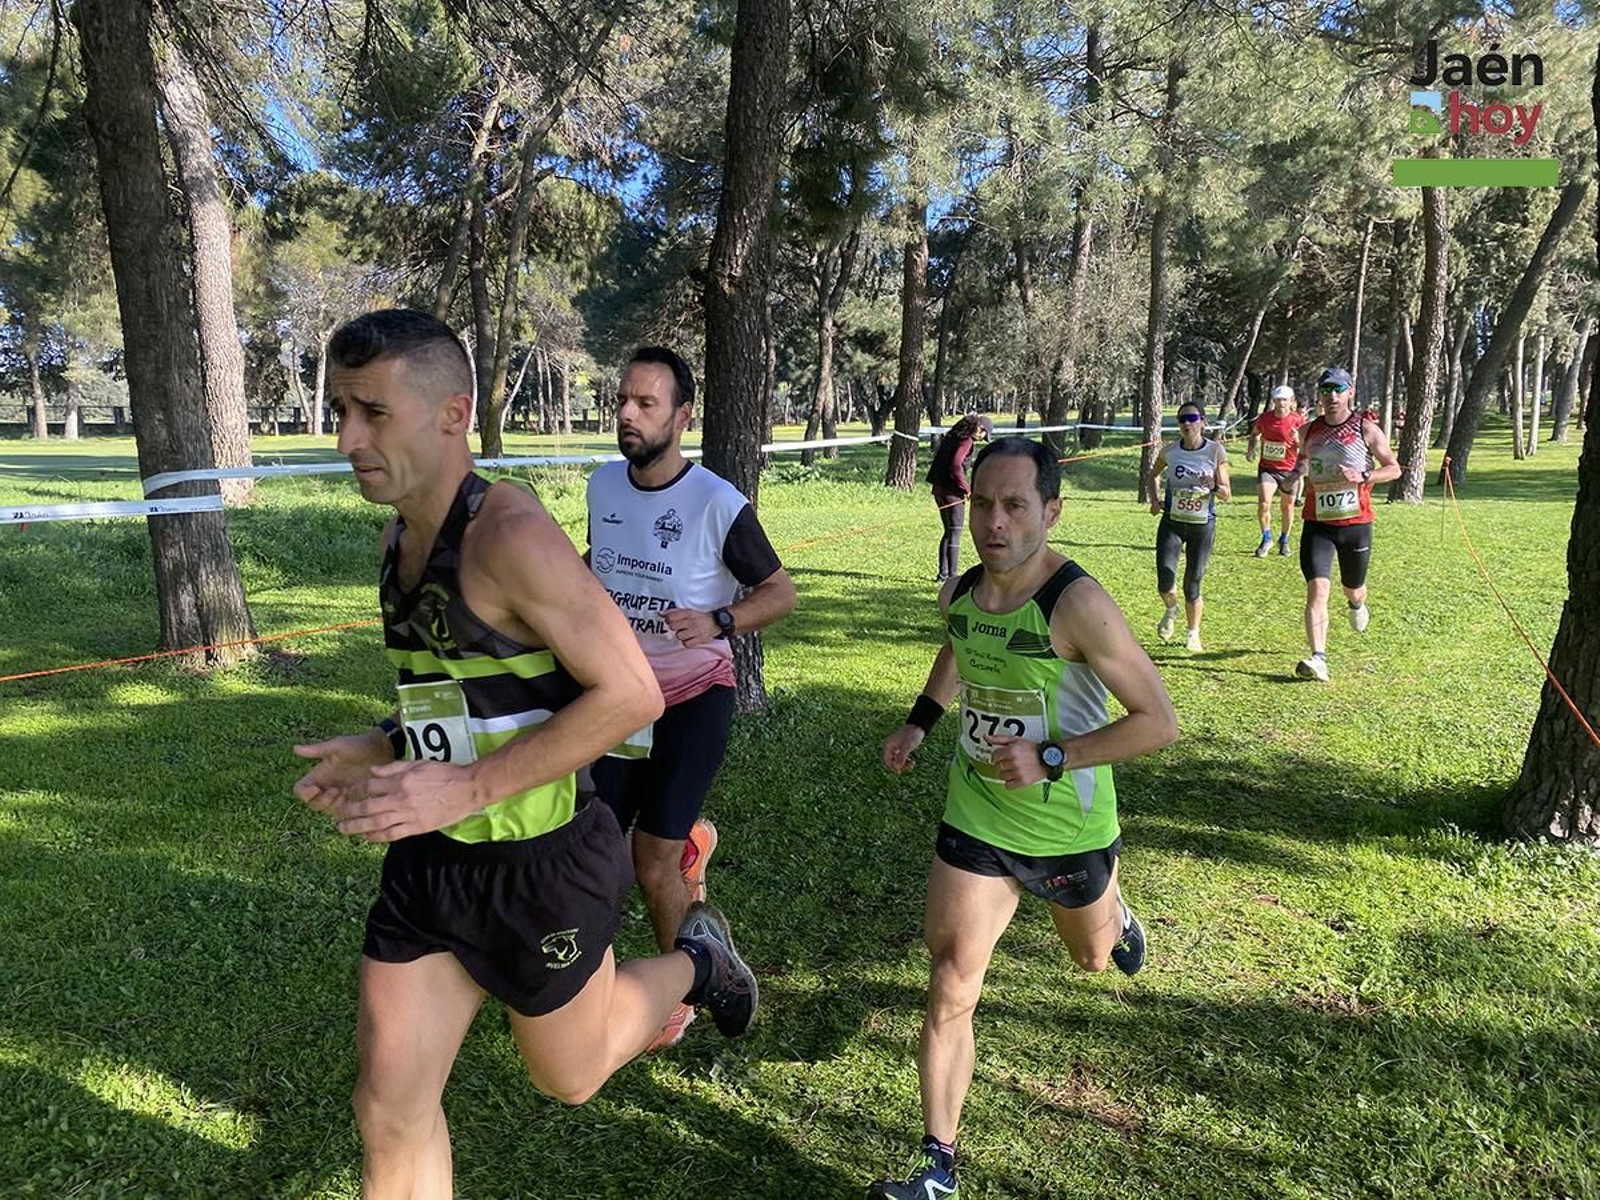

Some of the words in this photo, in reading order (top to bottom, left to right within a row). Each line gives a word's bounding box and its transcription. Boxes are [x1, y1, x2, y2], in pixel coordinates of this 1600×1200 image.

[1177, 498, 1203, 512] 559
[1318, 491, 1355, 507] 1072
[616, 553, 673, 576] Imporalia
[628, 616, 669, 635] TRAIL
